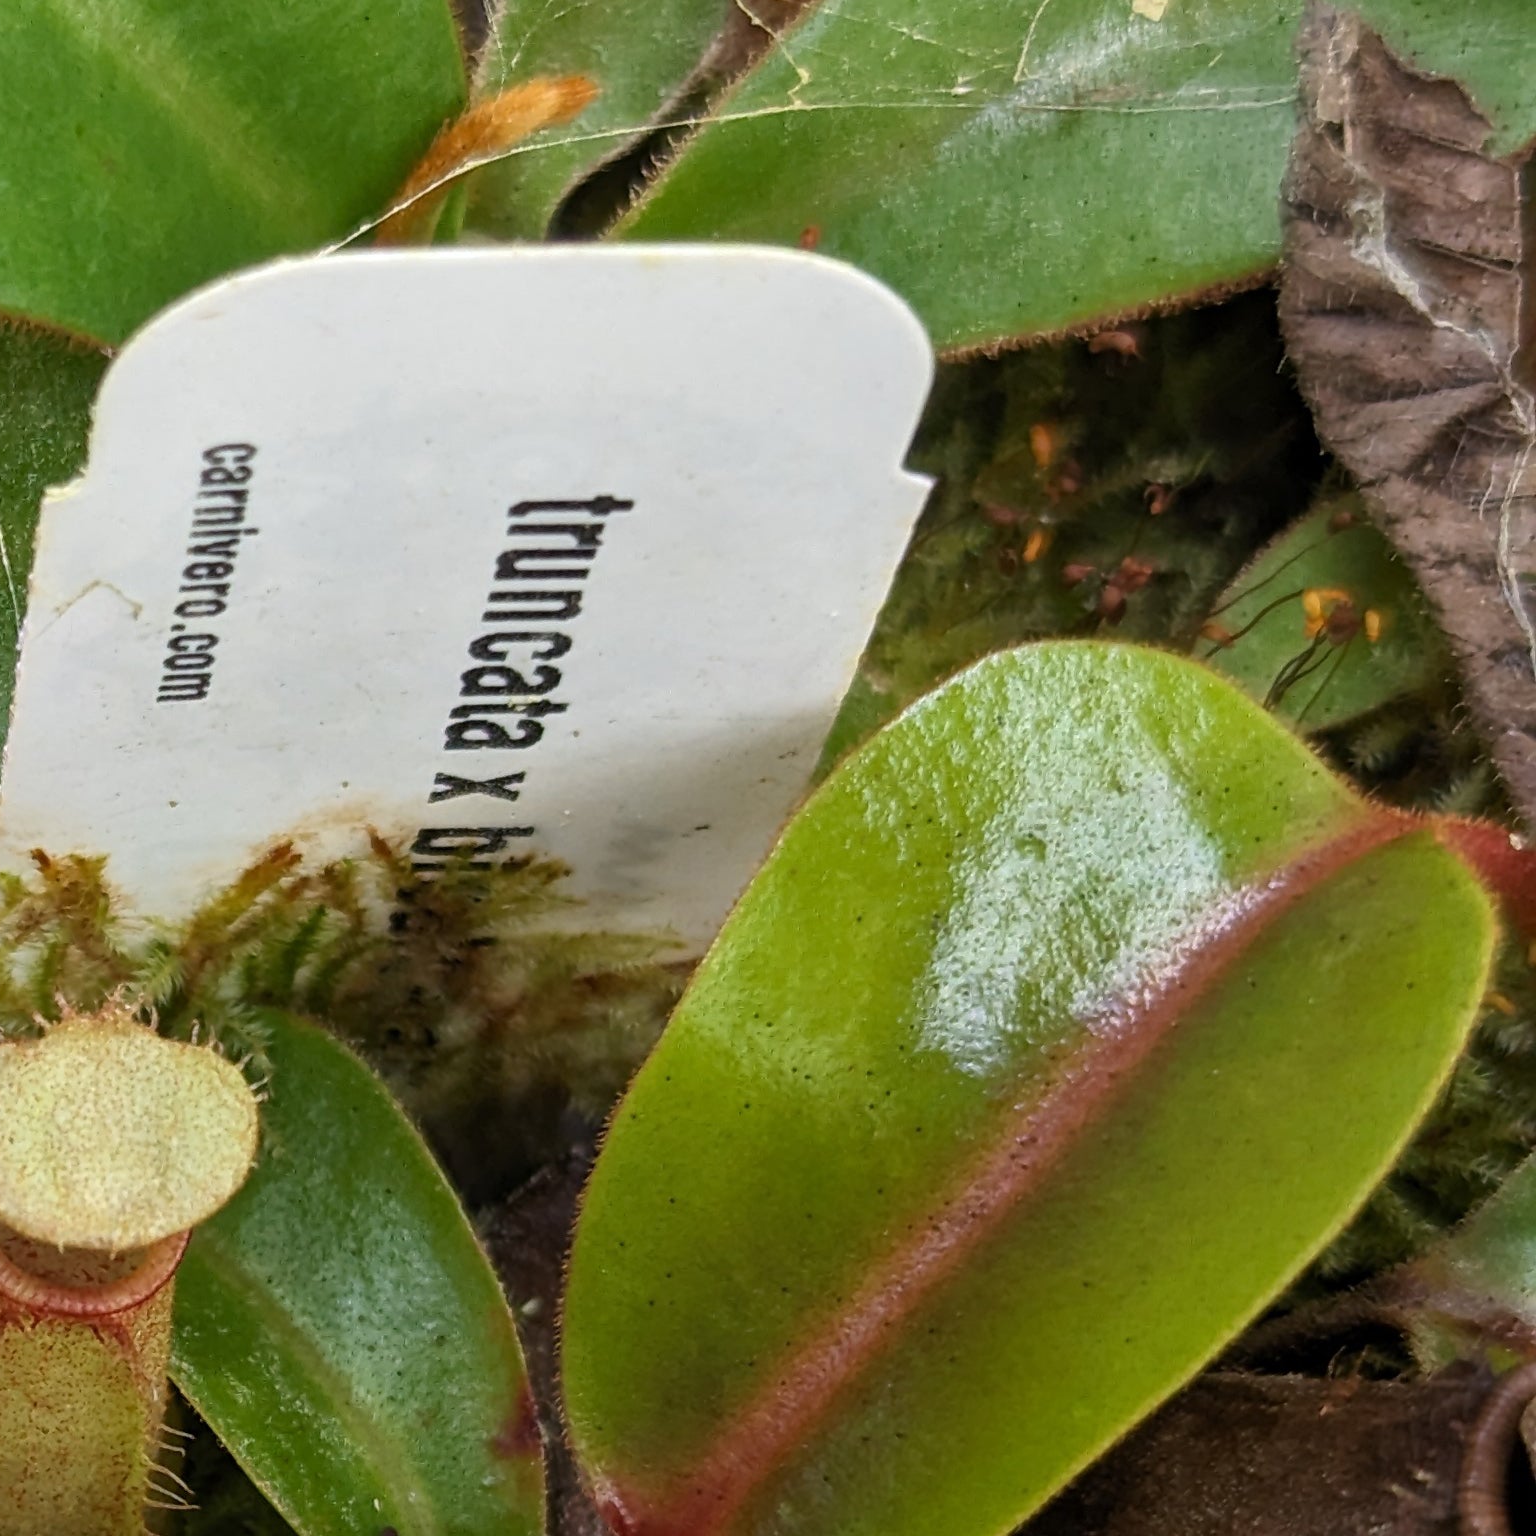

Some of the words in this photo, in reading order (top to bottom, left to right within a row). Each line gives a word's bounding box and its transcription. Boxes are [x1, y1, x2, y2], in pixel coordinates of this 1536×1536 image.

[156, 442, 259, 703] carnivero.com
[443, 495, 636, 751] truncata
[427, 771, 527, 804] x
